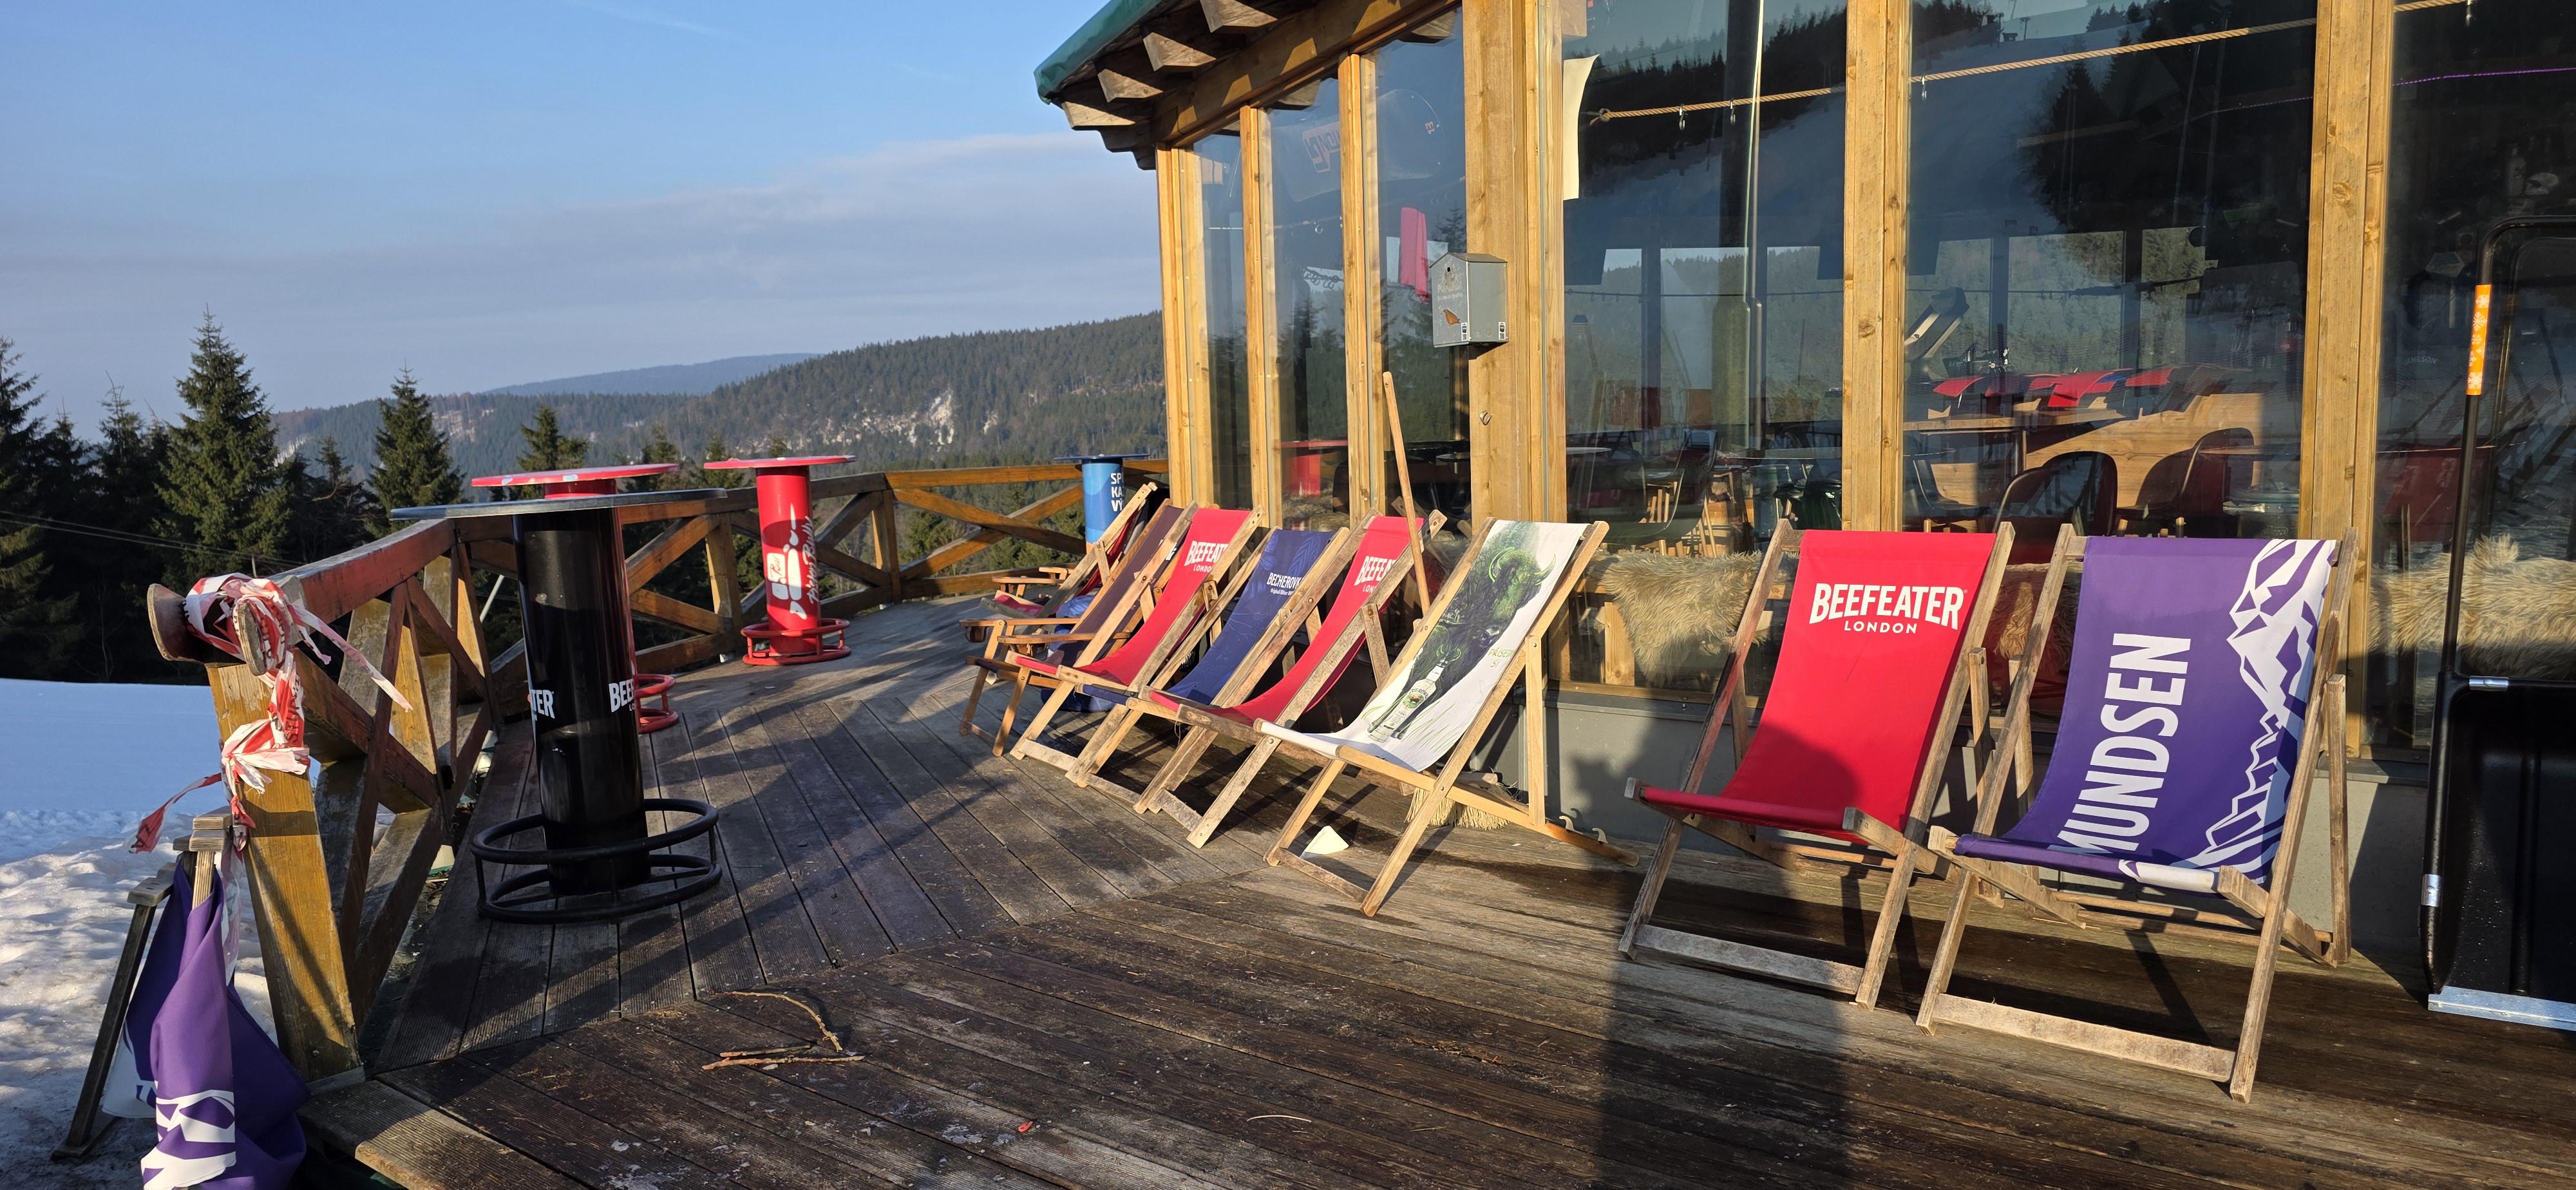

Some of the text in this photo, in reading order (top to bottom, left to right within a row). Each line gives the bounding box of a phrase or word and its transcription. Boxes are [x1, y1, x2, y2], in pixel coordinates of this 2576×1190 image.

[1184, 540, 1229, 567] BEEFEAT
[1193, 564, 1211, 573] LONDO
[1354, 556, 1396, 586] BEEFEA
[1266, 572, 1302, 589] BECHEROVK
[1362, 584, 1377, 594] LON
[1809, 583, 1964, 630] BEEFEATER
[1844, 620, 1917, 634] LONDON
[2048, 633, 2192, 854] MUNDSEN
